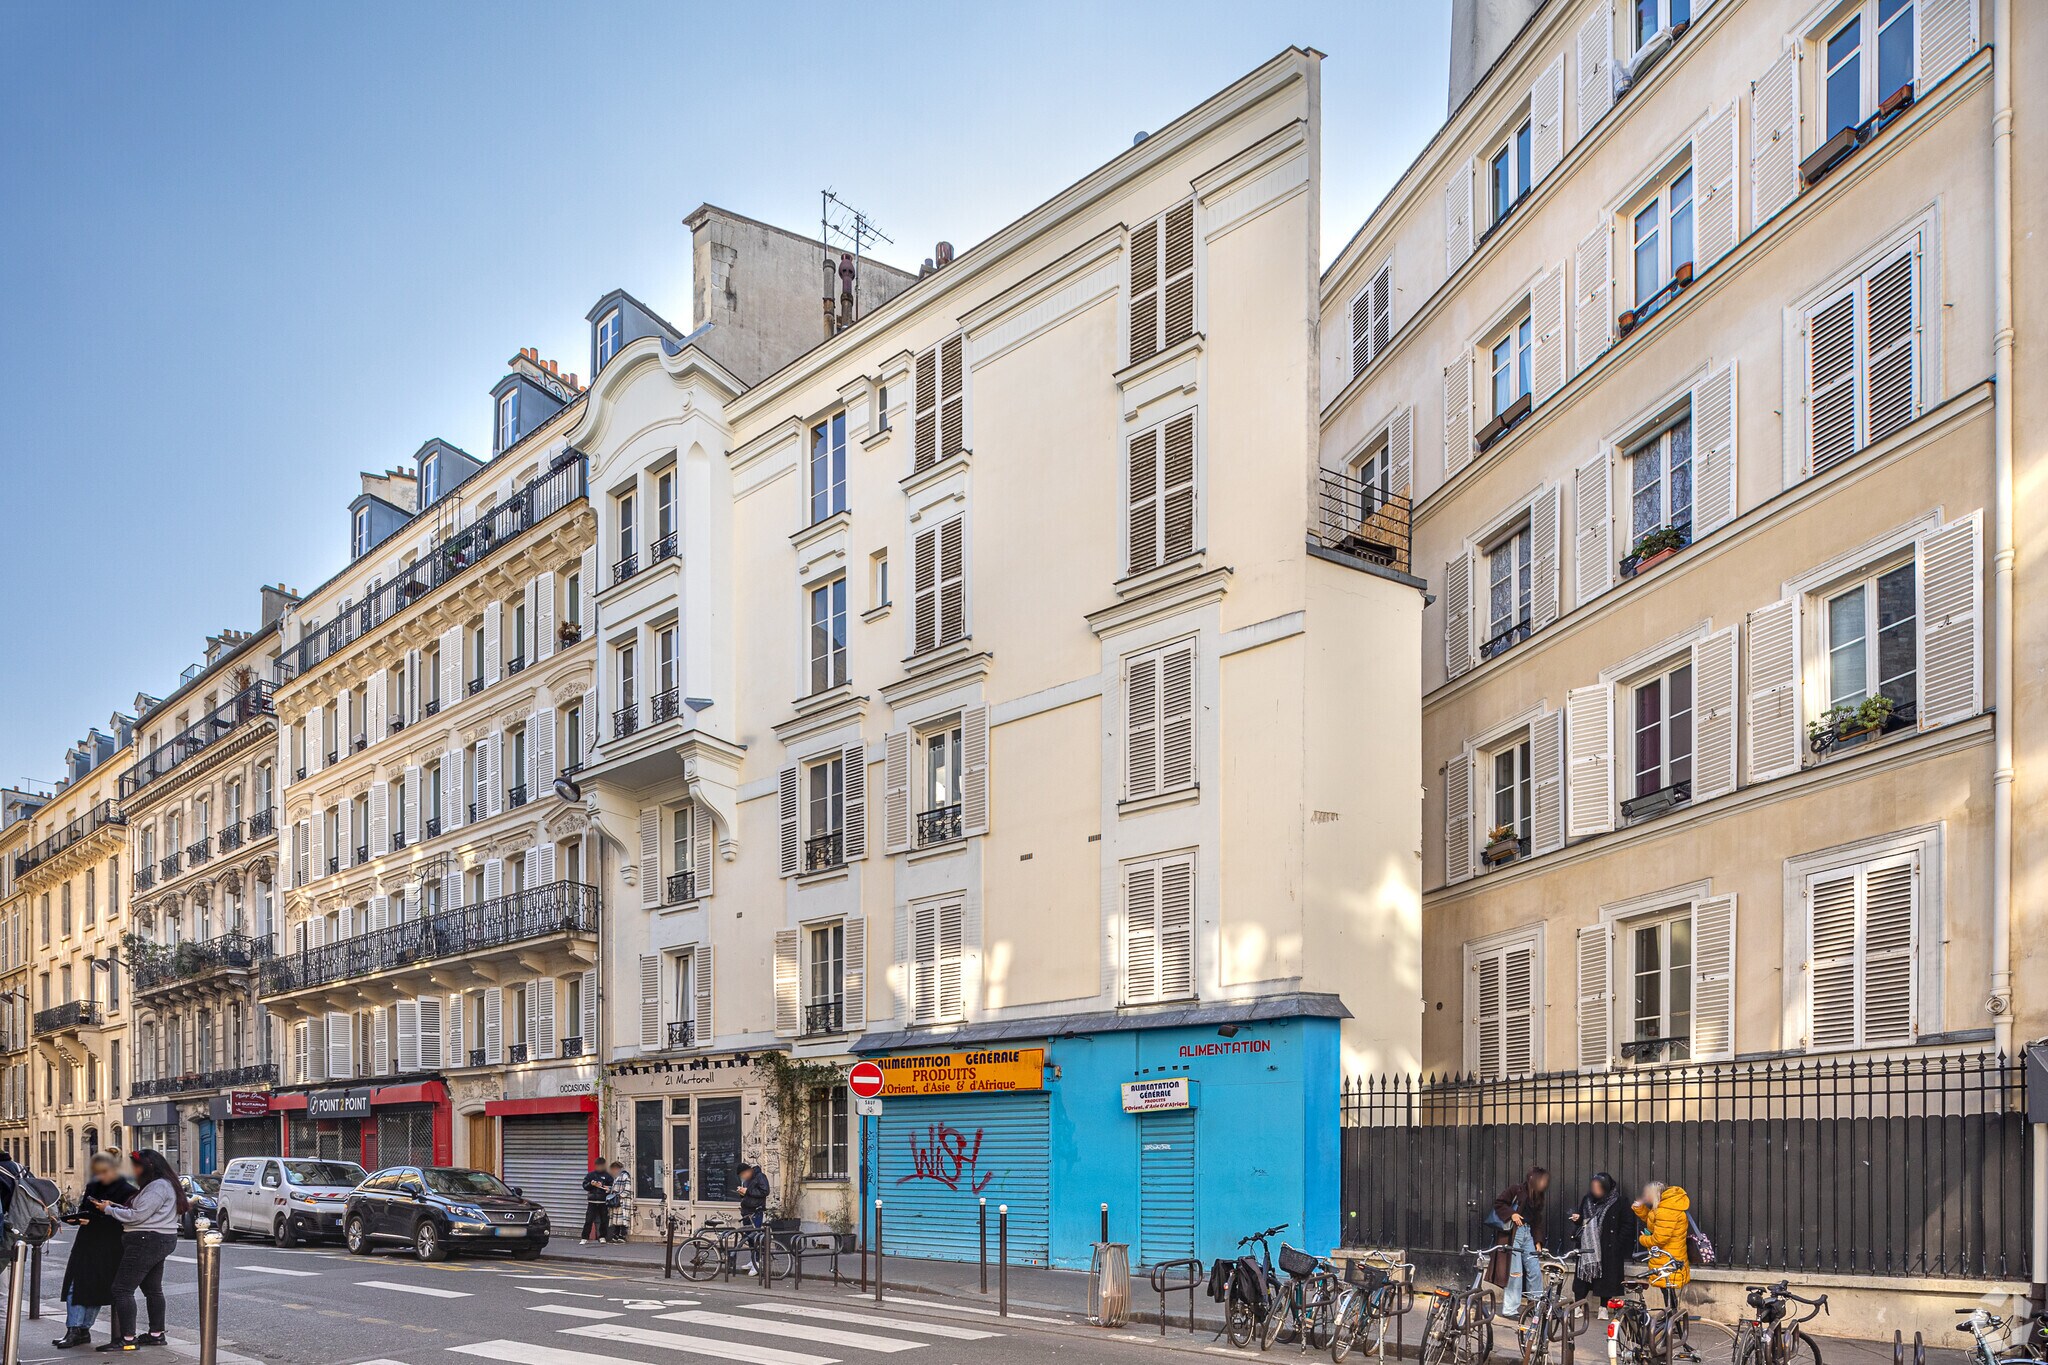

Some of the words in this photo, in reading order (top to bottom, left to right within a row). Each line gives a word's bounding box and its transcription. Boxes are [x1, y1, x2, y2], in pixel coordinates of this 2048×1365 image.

[1180, 1040, 1270, 1057] ALIMENTATION
[878, 1055, 950, 1070] ALIMENTATION
[965, 1051, 1020, 1065] GÉNÉRALE
[664, 1075, 673, 1085] 21
[676, 1071, 715, 1084] Martorell
[913, 1067, 977, 1082] PRODUITS
[560, 1083, 591, 1093] OCCASIONS
[923, 1081, 950, 1092] d'Asie
[956, 1080, 965, 1091] &
[970, 1079, 1016, 1091] d'Afrique
[1130, 1081, 1180, 1092] ALIMENTATION
[1139, 1089, 1171, 1099] GÉNÉRALE
[319, 1098, 339, 1112] POINT
[340, 1099, 344, 1110] 2
[345, 1097, 367, 1110] POINT
